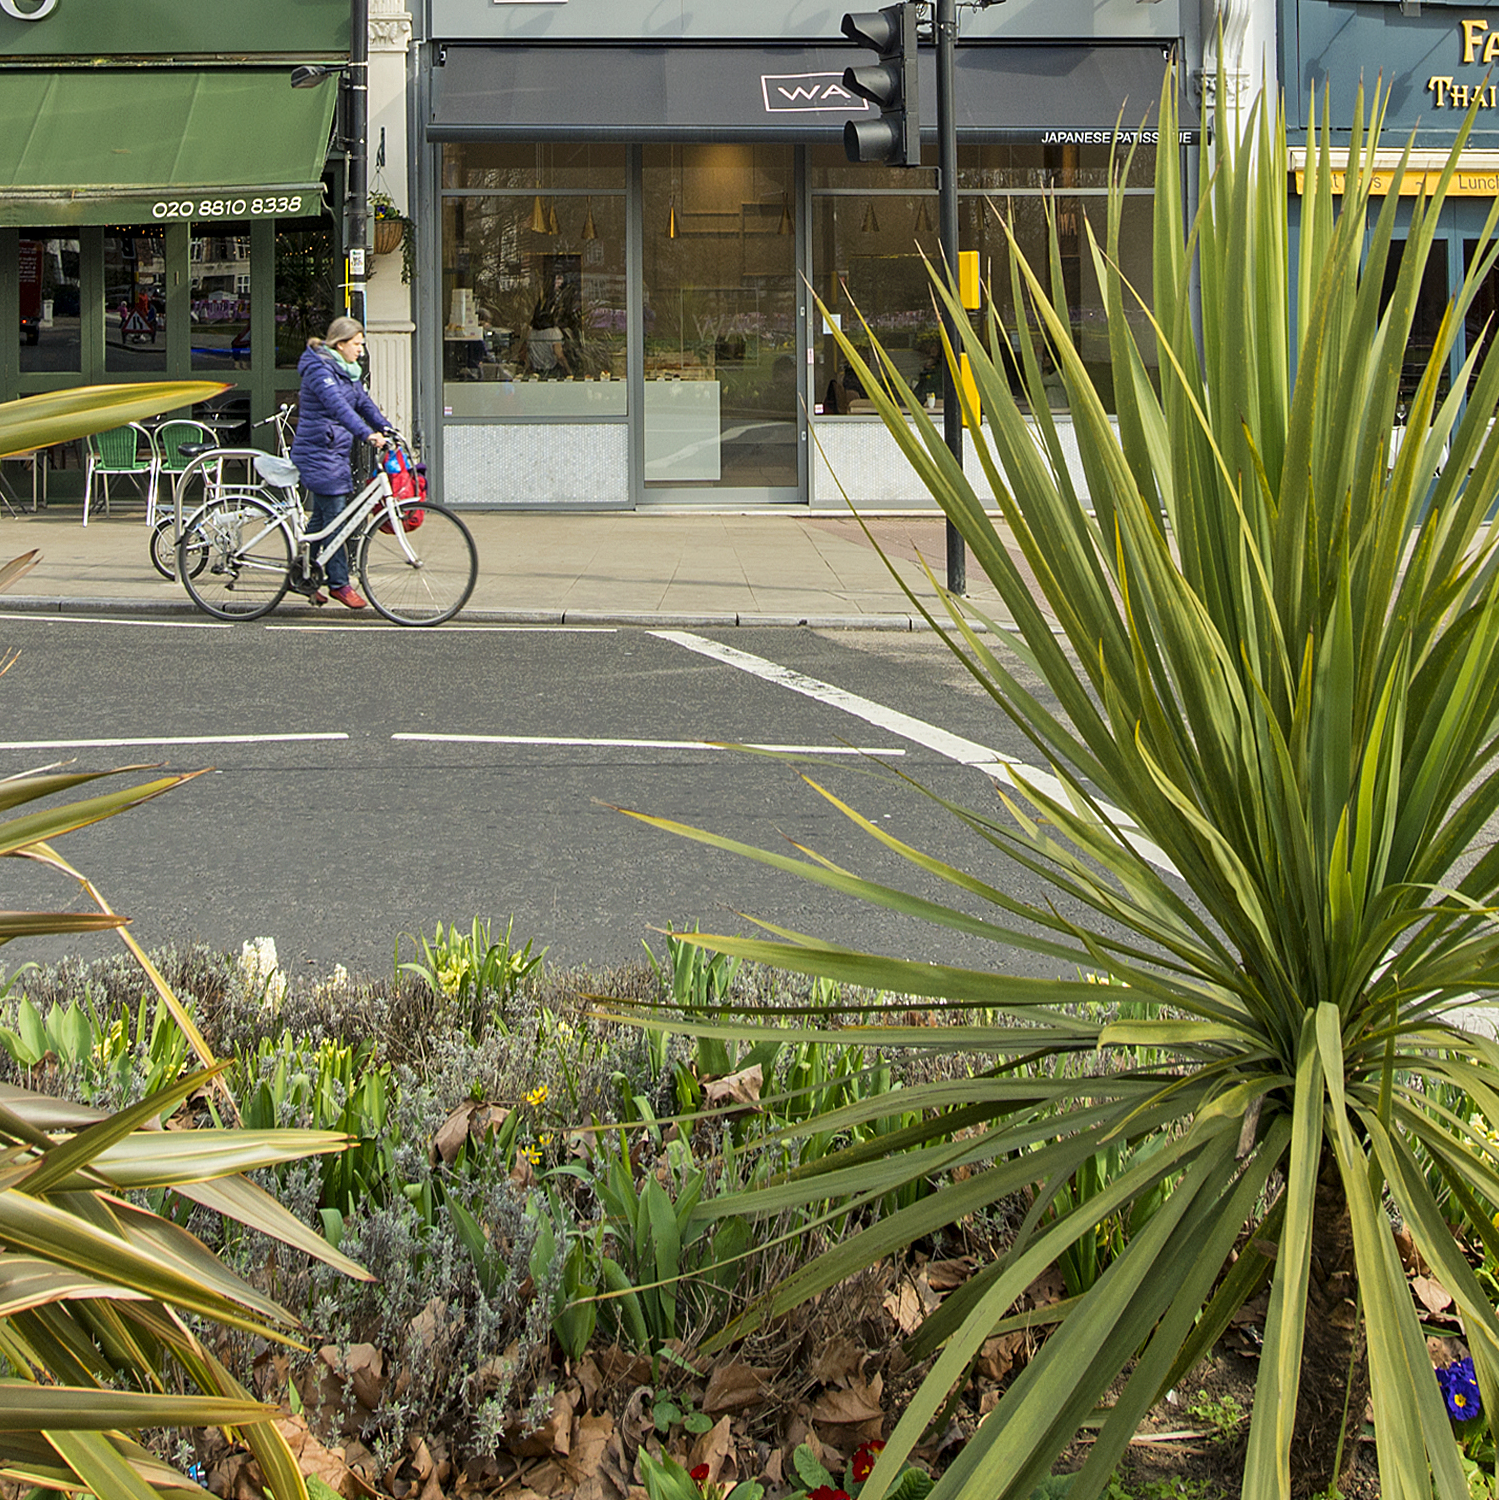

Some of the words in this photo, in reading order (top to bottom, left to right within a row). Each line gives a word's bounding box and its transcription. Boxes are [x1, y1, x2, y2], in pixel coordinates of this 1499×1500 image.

[777, 84, 851, 101] WA
[1041, 131, 1111, 144] JAPANESE
[1114, 131, 1192, 144] PATISSIE
[152, 201, 195, 218] 020
[198, 199, 247, 216] 8810
[251, 196, 302, 214] 8338
[693, 314, 747, 342] WA
